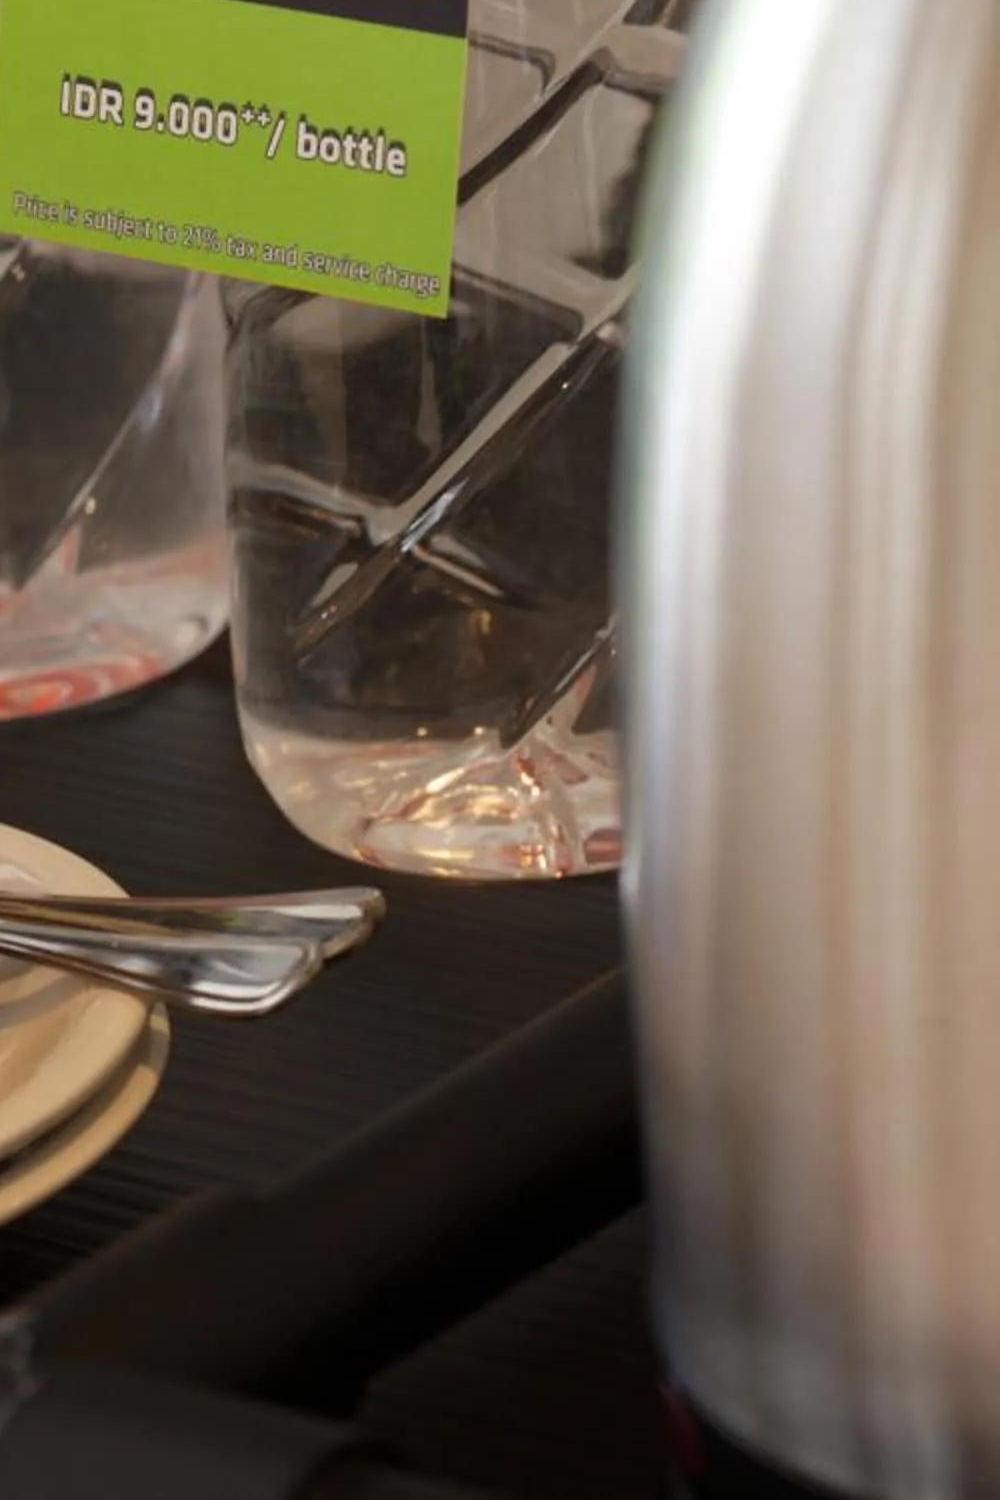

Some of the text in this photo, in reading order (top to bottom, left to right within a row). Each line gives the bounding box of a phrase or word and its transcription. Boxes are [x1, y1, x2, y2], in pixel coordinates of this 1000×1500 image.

[60, 73, 124, 126] IDR
[296, 114, 407, 177] bottle
[13, 190, 441, 299] Price is subject to 21% tax and service charge
